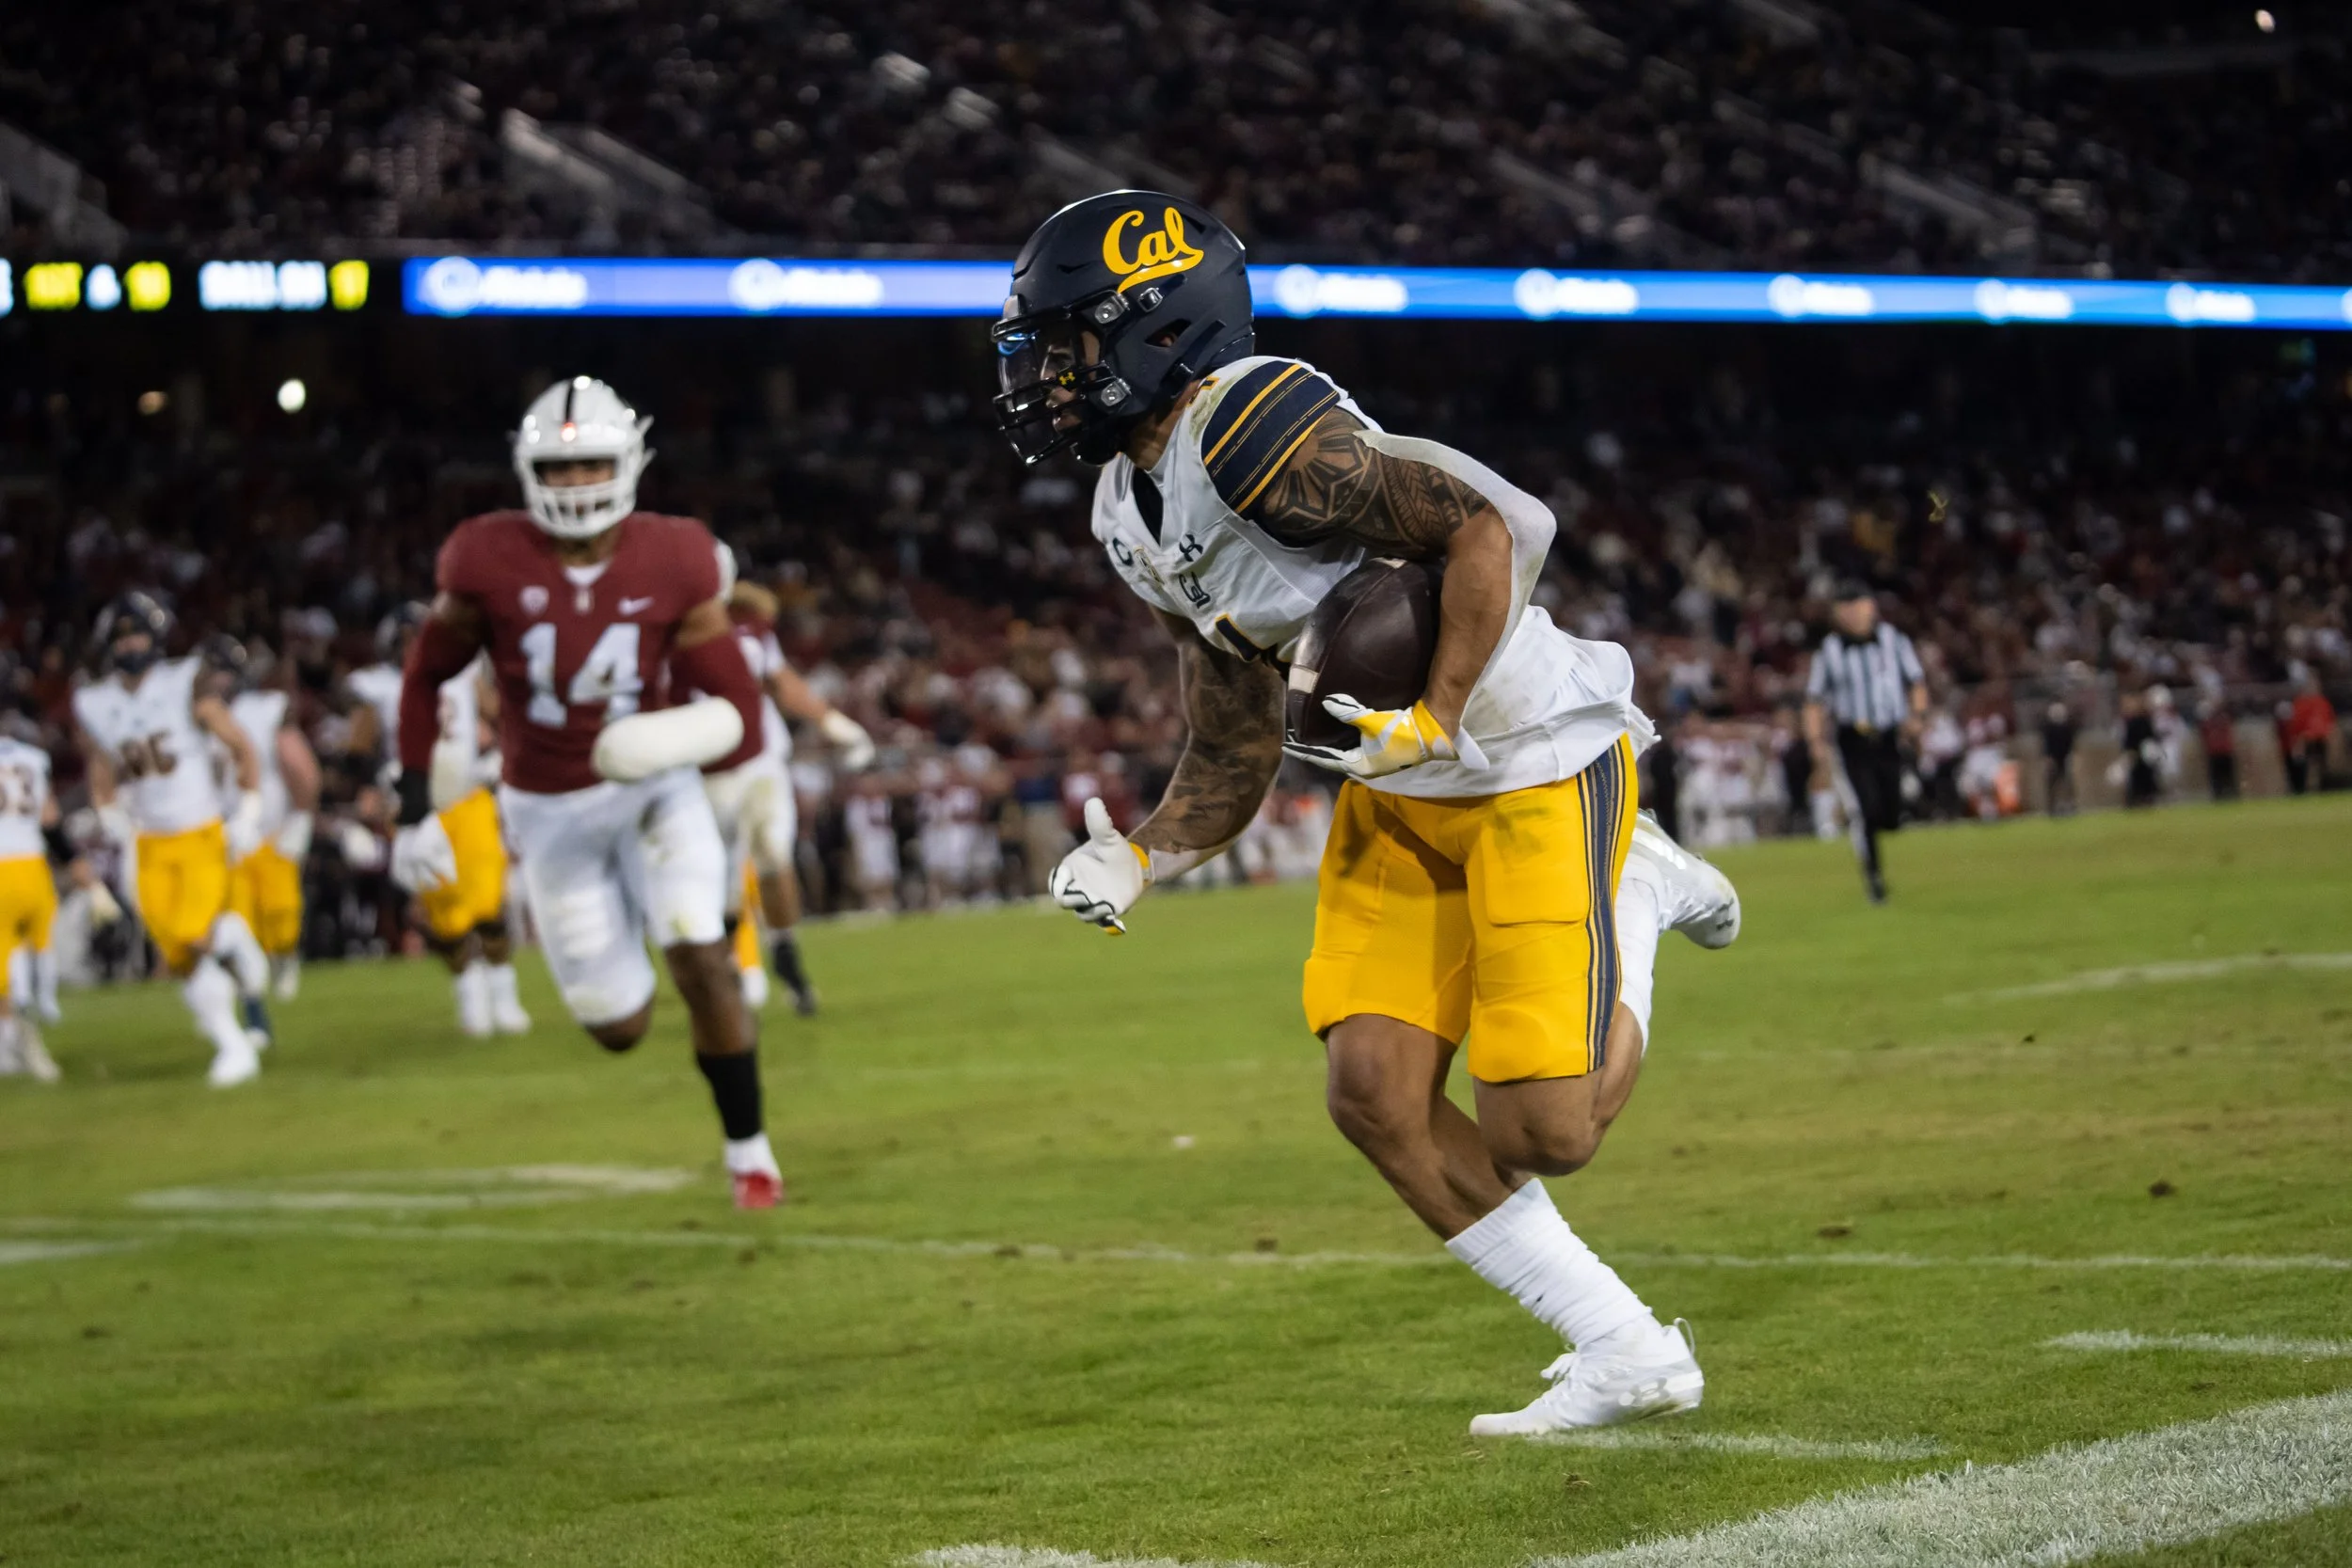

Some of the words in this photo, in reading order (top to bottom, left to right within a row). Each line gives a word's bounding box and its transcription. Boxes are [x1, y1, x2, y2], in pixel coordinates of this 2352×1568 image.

[1103, 207, 1204, 293] Cal
[1178, 571, 1212, 610] Cal
[519, 622, 644, 729] 14
